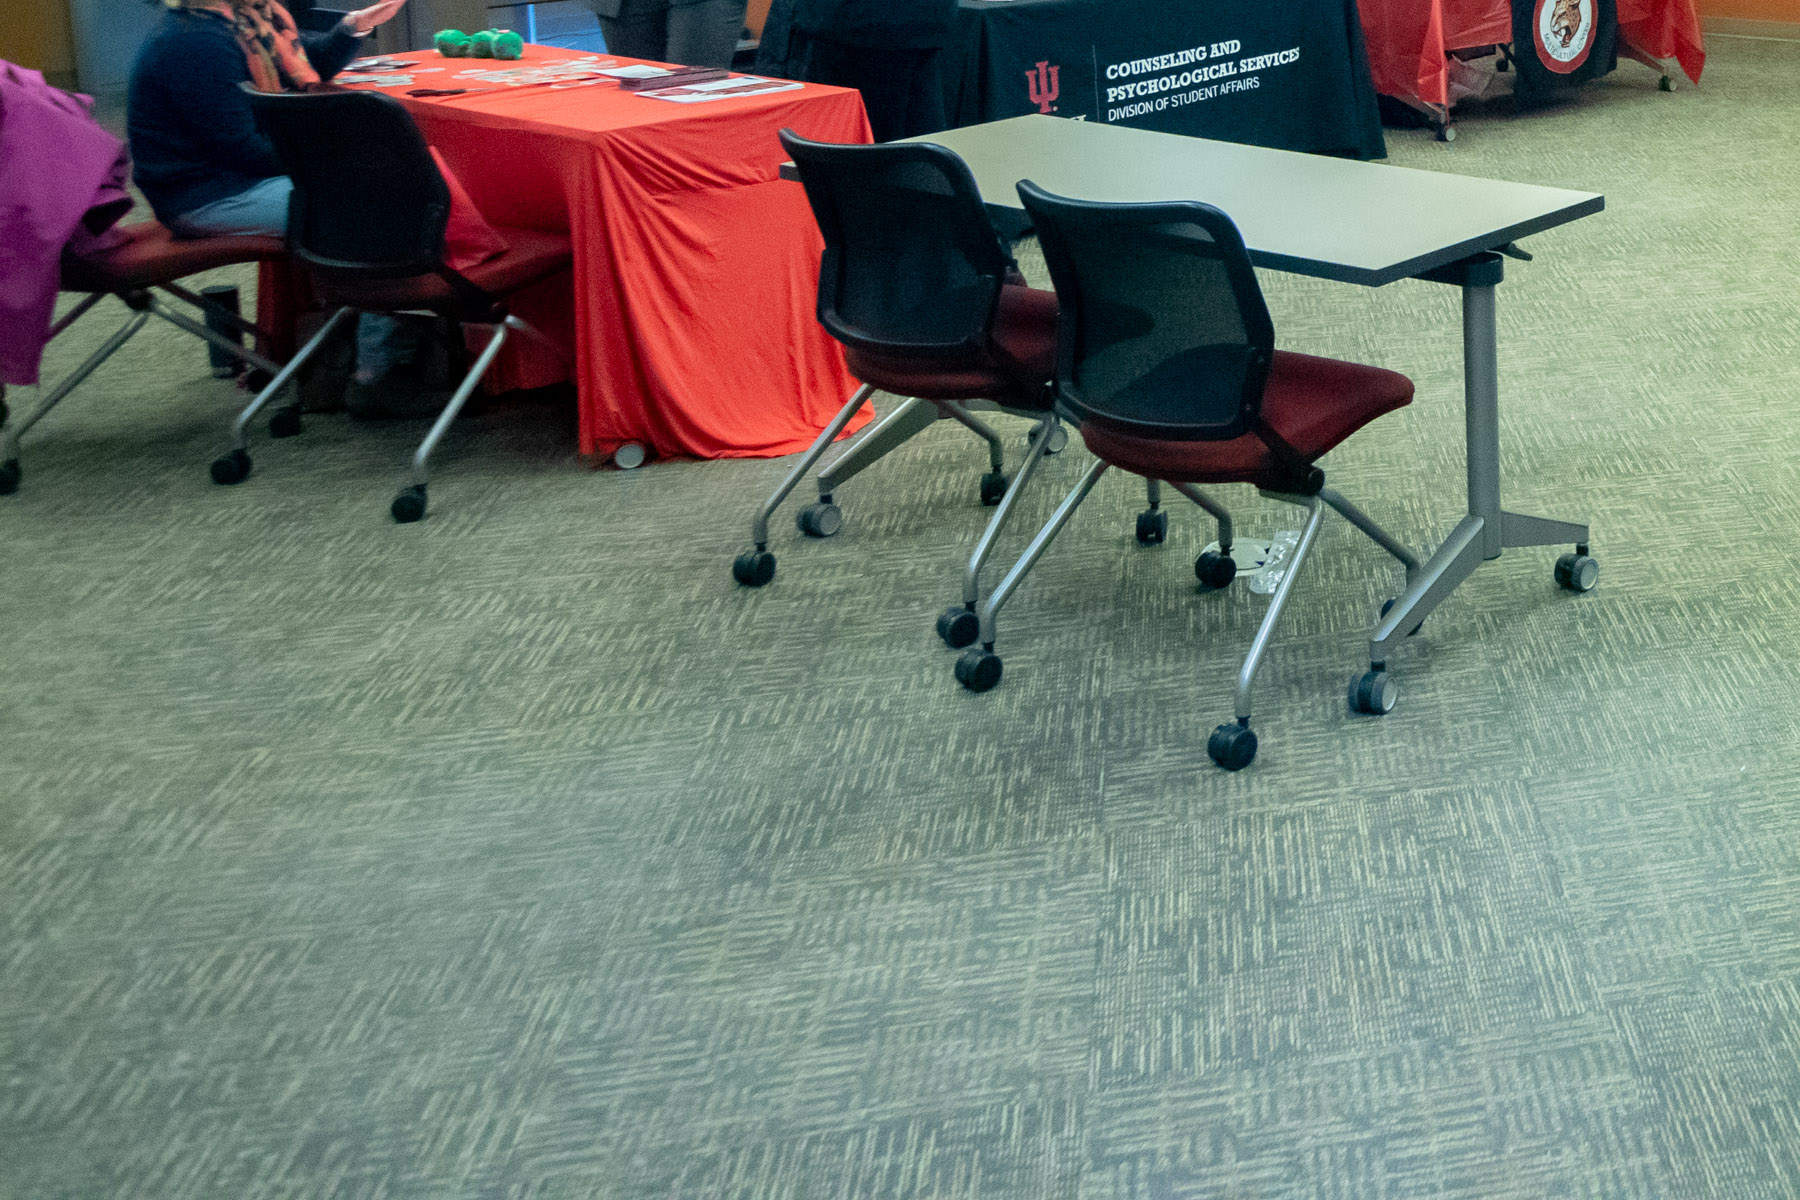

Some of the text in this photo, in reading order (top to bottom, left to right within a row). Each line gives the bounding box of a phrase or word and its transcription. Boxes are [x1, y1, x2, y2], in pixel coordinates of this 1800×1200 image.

[1106, 39, 1241, 80] COUNSELING AND
[1106, 61, 1237, 103] PSYCHOLOGICAL
[1108, 76, 1260, 122] DIVISION OF STUDENT AFFAIRS
